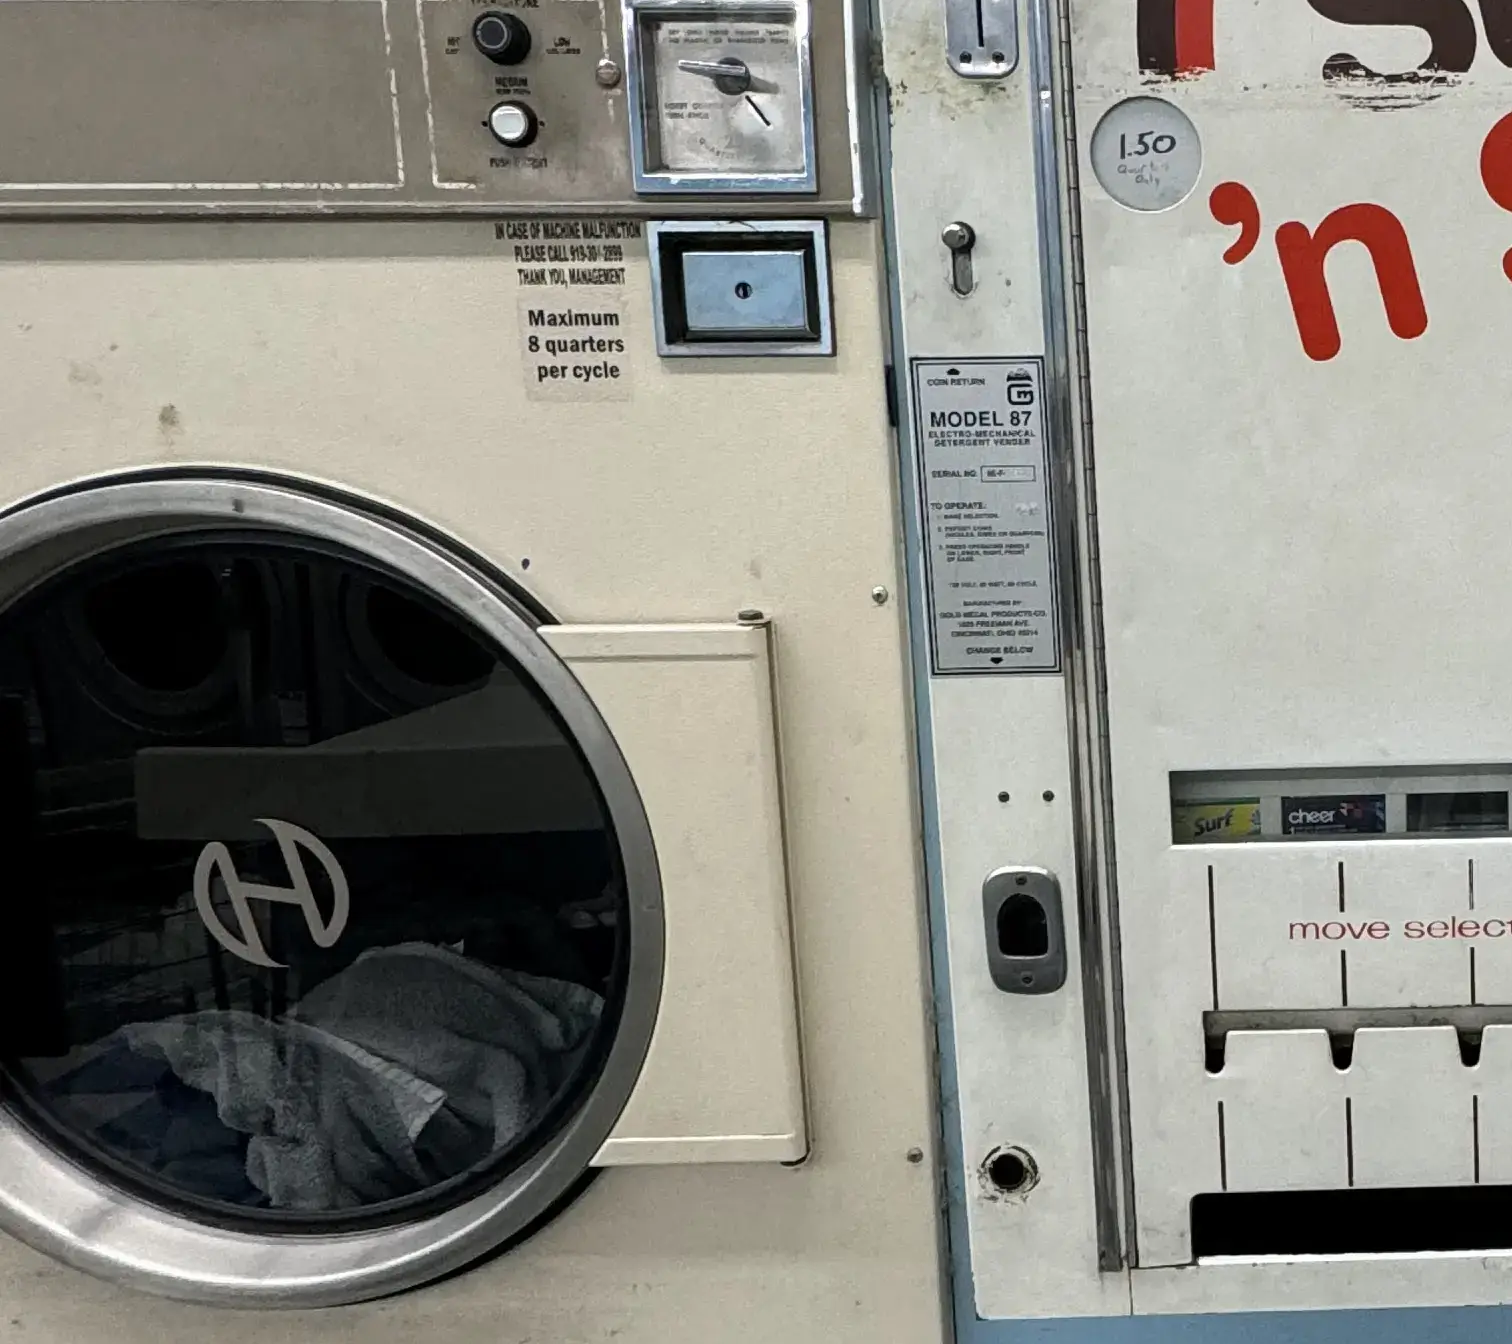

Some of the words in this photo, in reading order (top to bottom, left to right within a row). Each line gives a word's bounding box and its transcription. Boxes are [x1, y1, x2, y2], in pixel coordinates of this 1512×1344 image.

[1120, 130, 1177, 159] 1.50
[495, 223, 505, 239] IN
[506, 222, 529, 239] CASE
[529, 222, 541, 239] OF
[542, 222, 581, 239] MACHINE
[582, 220, 642, 239] MALFUNCTION
[514, 245, 546, 262] PLEASE
[547, 245, 570, 262] CALL
[517, 268, 547, 285] THANK
[568, 267, 626, 285] MANAGEMENT
[1209, 181, 1428, 362] 'n
[528, 309, 620, 326] Maximum
[528, 336, 540, 353] 8
[545, 336, 625, 357] quarters
[538, 364, 568, 382] per
[572, 361, 620, 382] cycle
[950, 378, 985, 386] RETURN
[930, 411, 1004, 427] MODEL
[1010, 411, 1032, 426] 87
[1193, 808, 1234, 836] Surf
[1288, 808, 1336, 825] cheer
[1288, 920, 1391, 940] move
